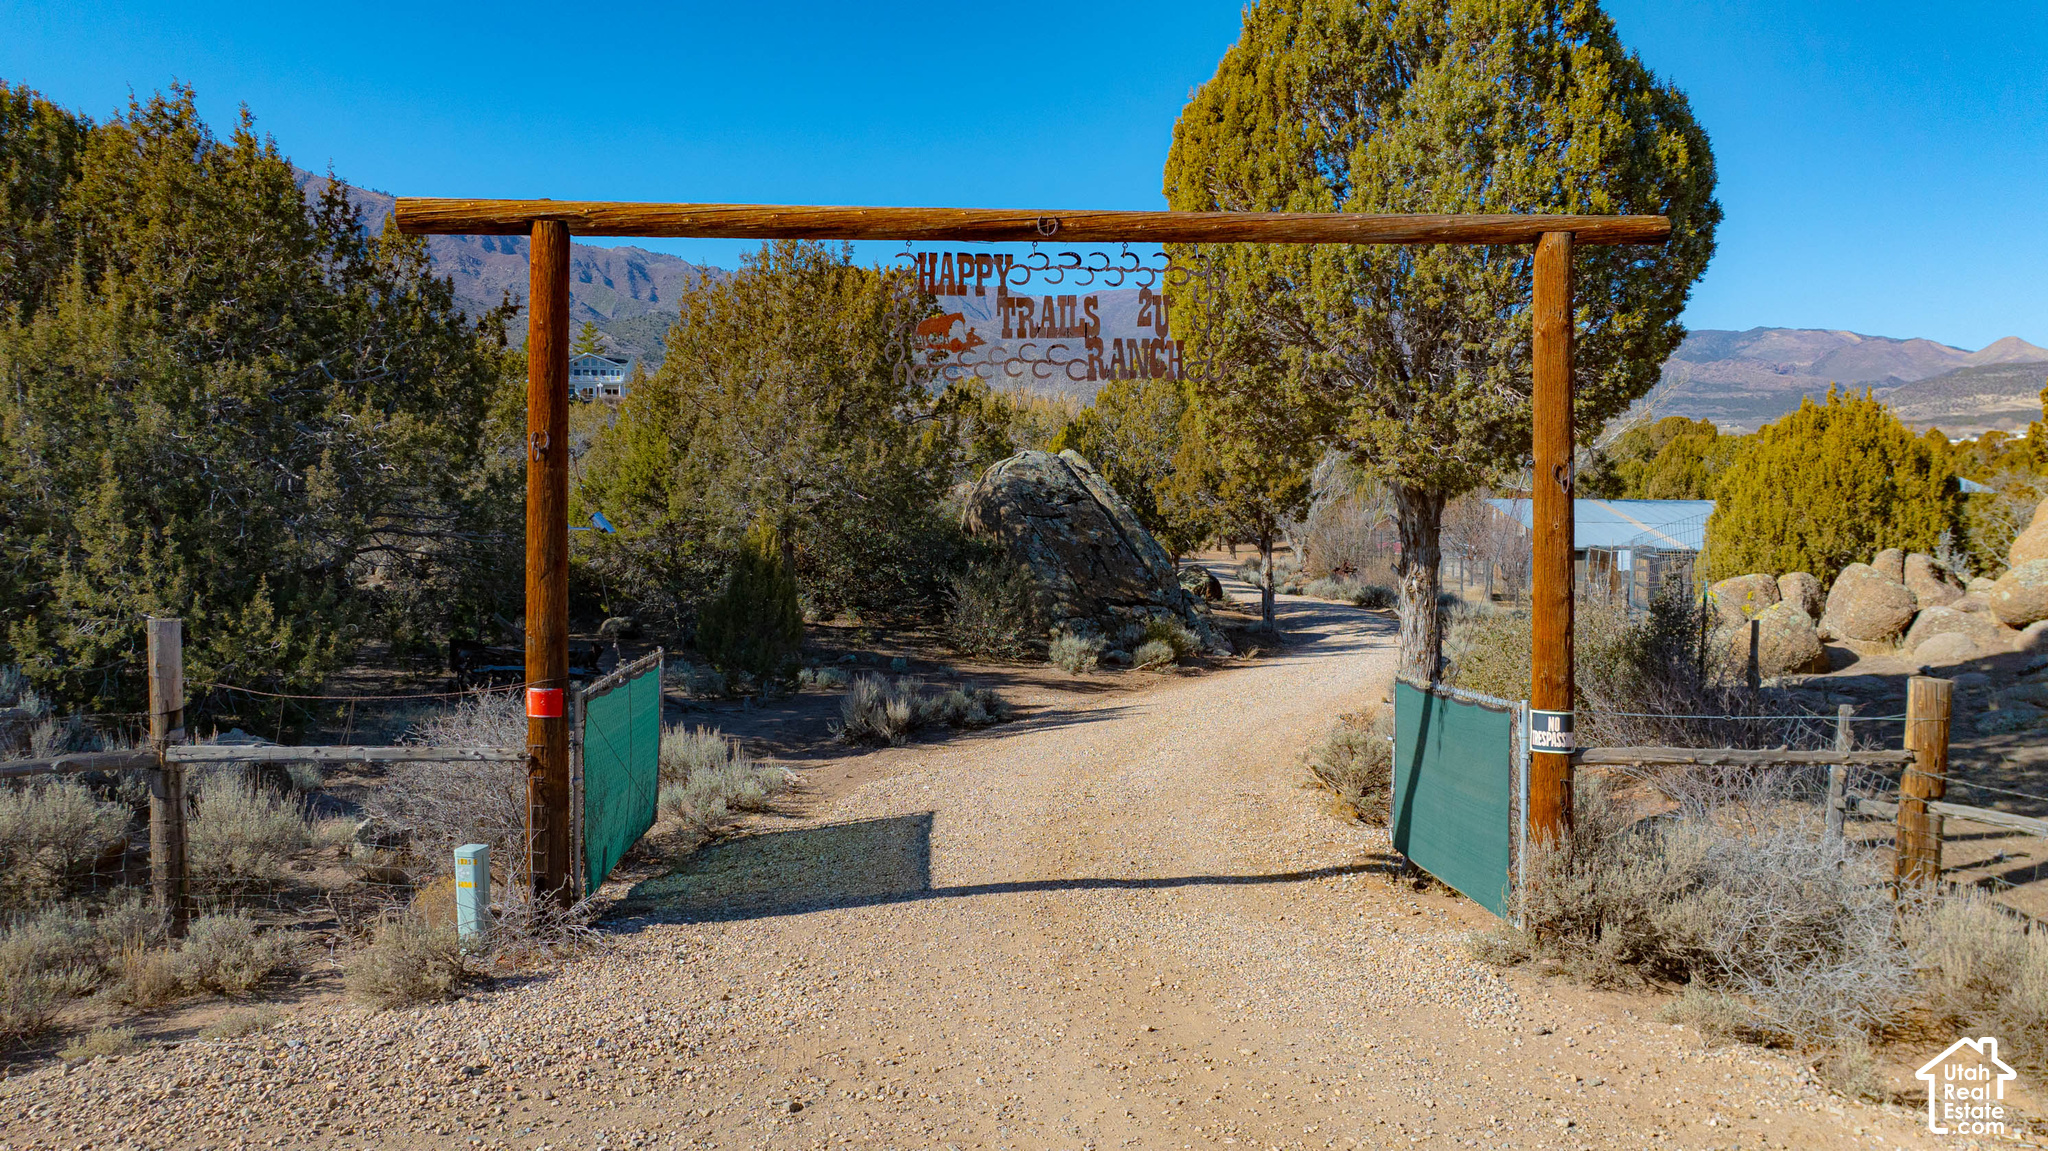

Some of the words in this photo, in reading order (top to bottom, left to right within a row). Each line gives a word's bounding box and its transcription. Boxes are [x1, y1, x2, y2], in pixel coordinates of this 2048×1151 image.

[917, 252, 1014, 297] HAPPY
[997, 294, 1099, 339] TRAILS
[1085, 338, 1185, 382] RANCH
[1548, 716, 1560, 732] NO
